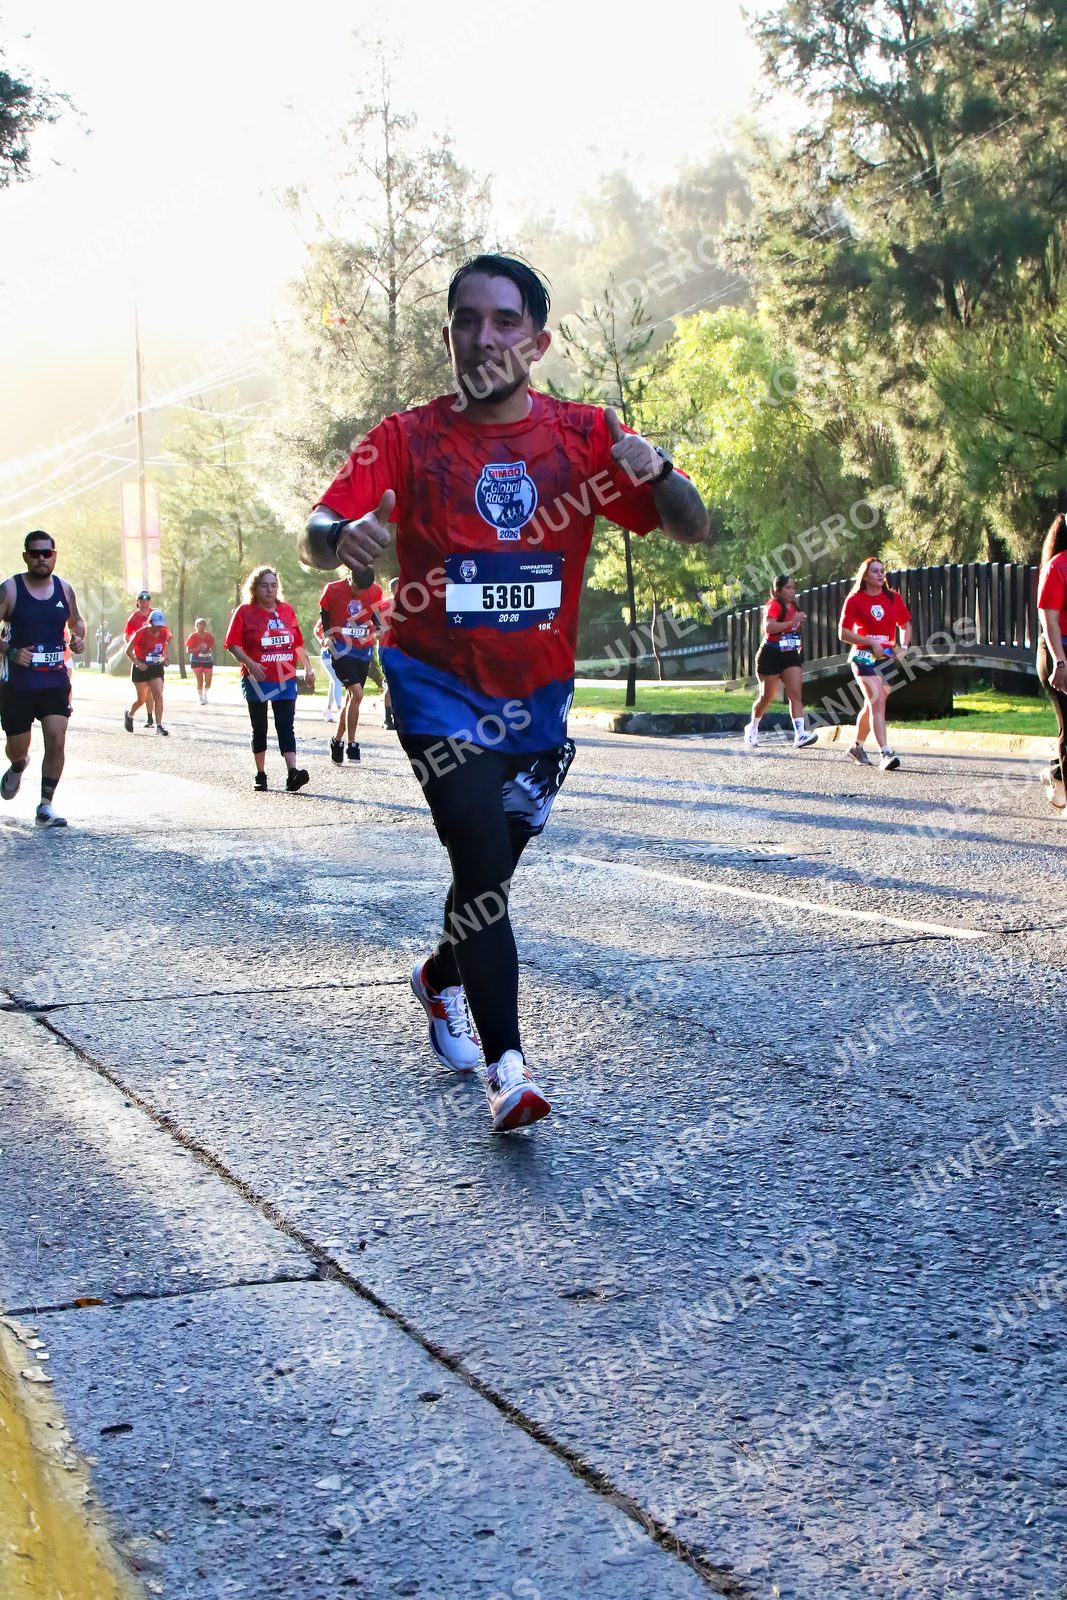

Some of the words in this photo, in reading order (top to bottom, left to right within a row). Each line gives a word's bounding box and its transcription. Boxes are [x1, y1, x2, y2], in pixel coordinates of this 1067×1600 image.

[488, 468, 521, 478] BIMBO
[490, 481, 521, 493] Global
[485, 492, 511, 503] Race
[499, 530, 519, 539] 2026
[482, 584, 535, 610] 5360
[538, 623, 551, 631] 10K
[261, 654, 293, 662] SANTIAGO
